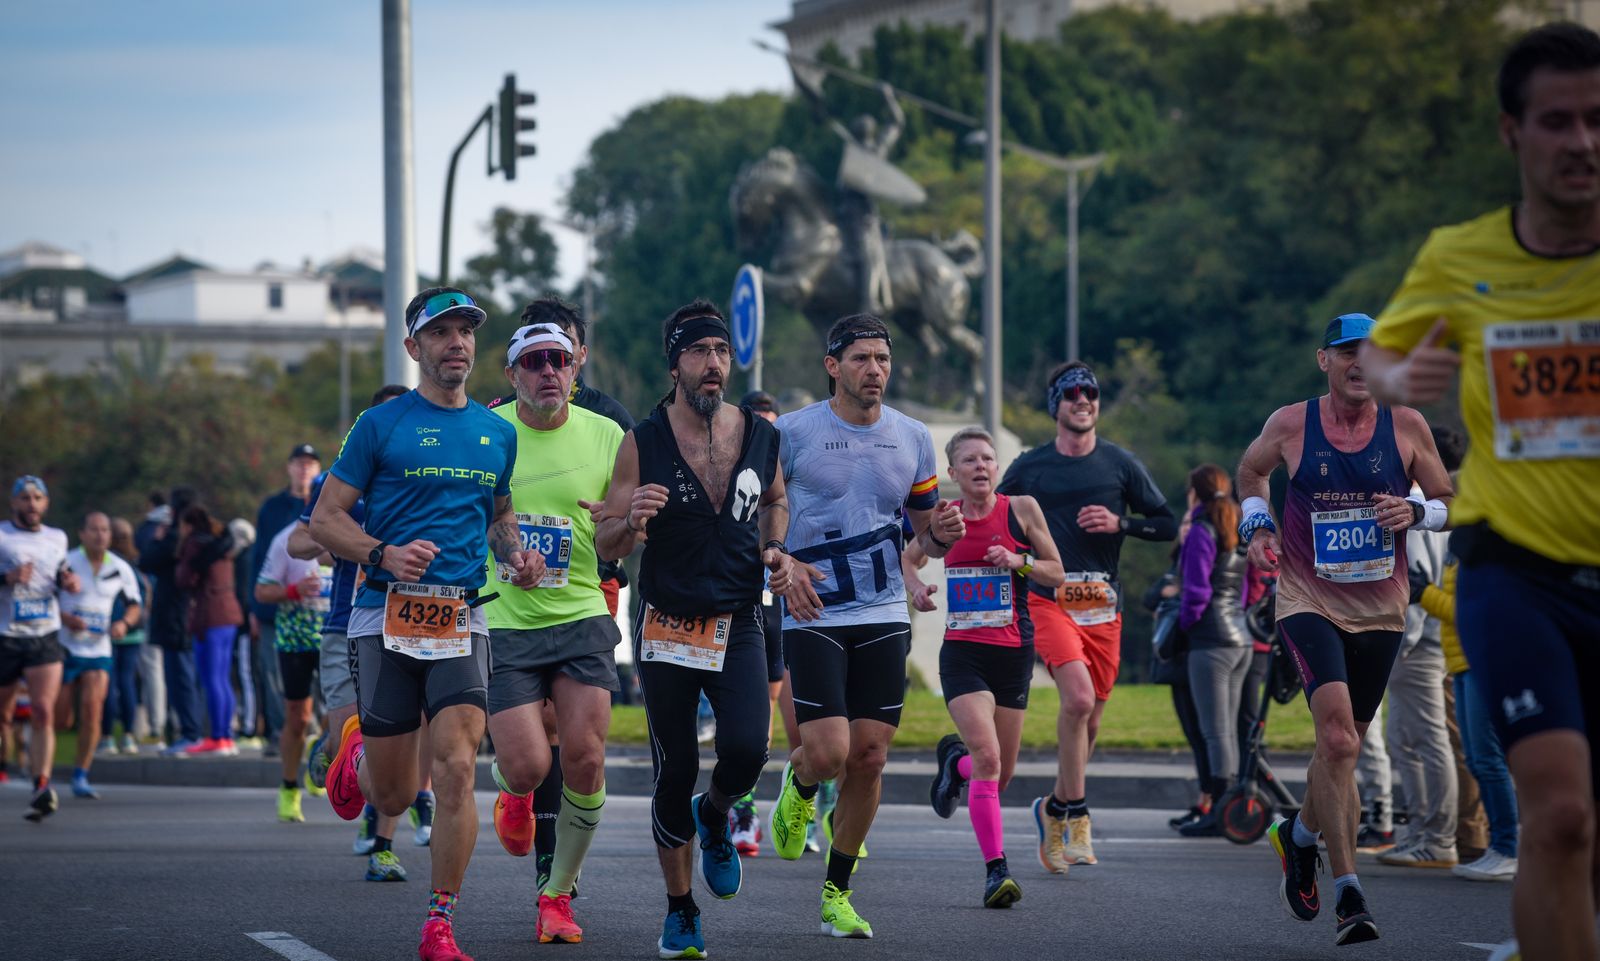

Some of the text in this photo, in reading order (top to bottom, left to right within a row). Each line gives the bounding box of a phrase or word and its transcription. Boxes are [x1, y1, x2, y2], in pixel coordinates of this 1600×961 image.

[1511, 354, 1600, 397] 3825
[404, 467, 497, 482] KANINA
[1313, 490, 1365, 501] PÉGATE
[1326, 526, 1378, 551] 2804
[954, 581, 995, 602] 1914
[398, 600, 453, 626] 4328
